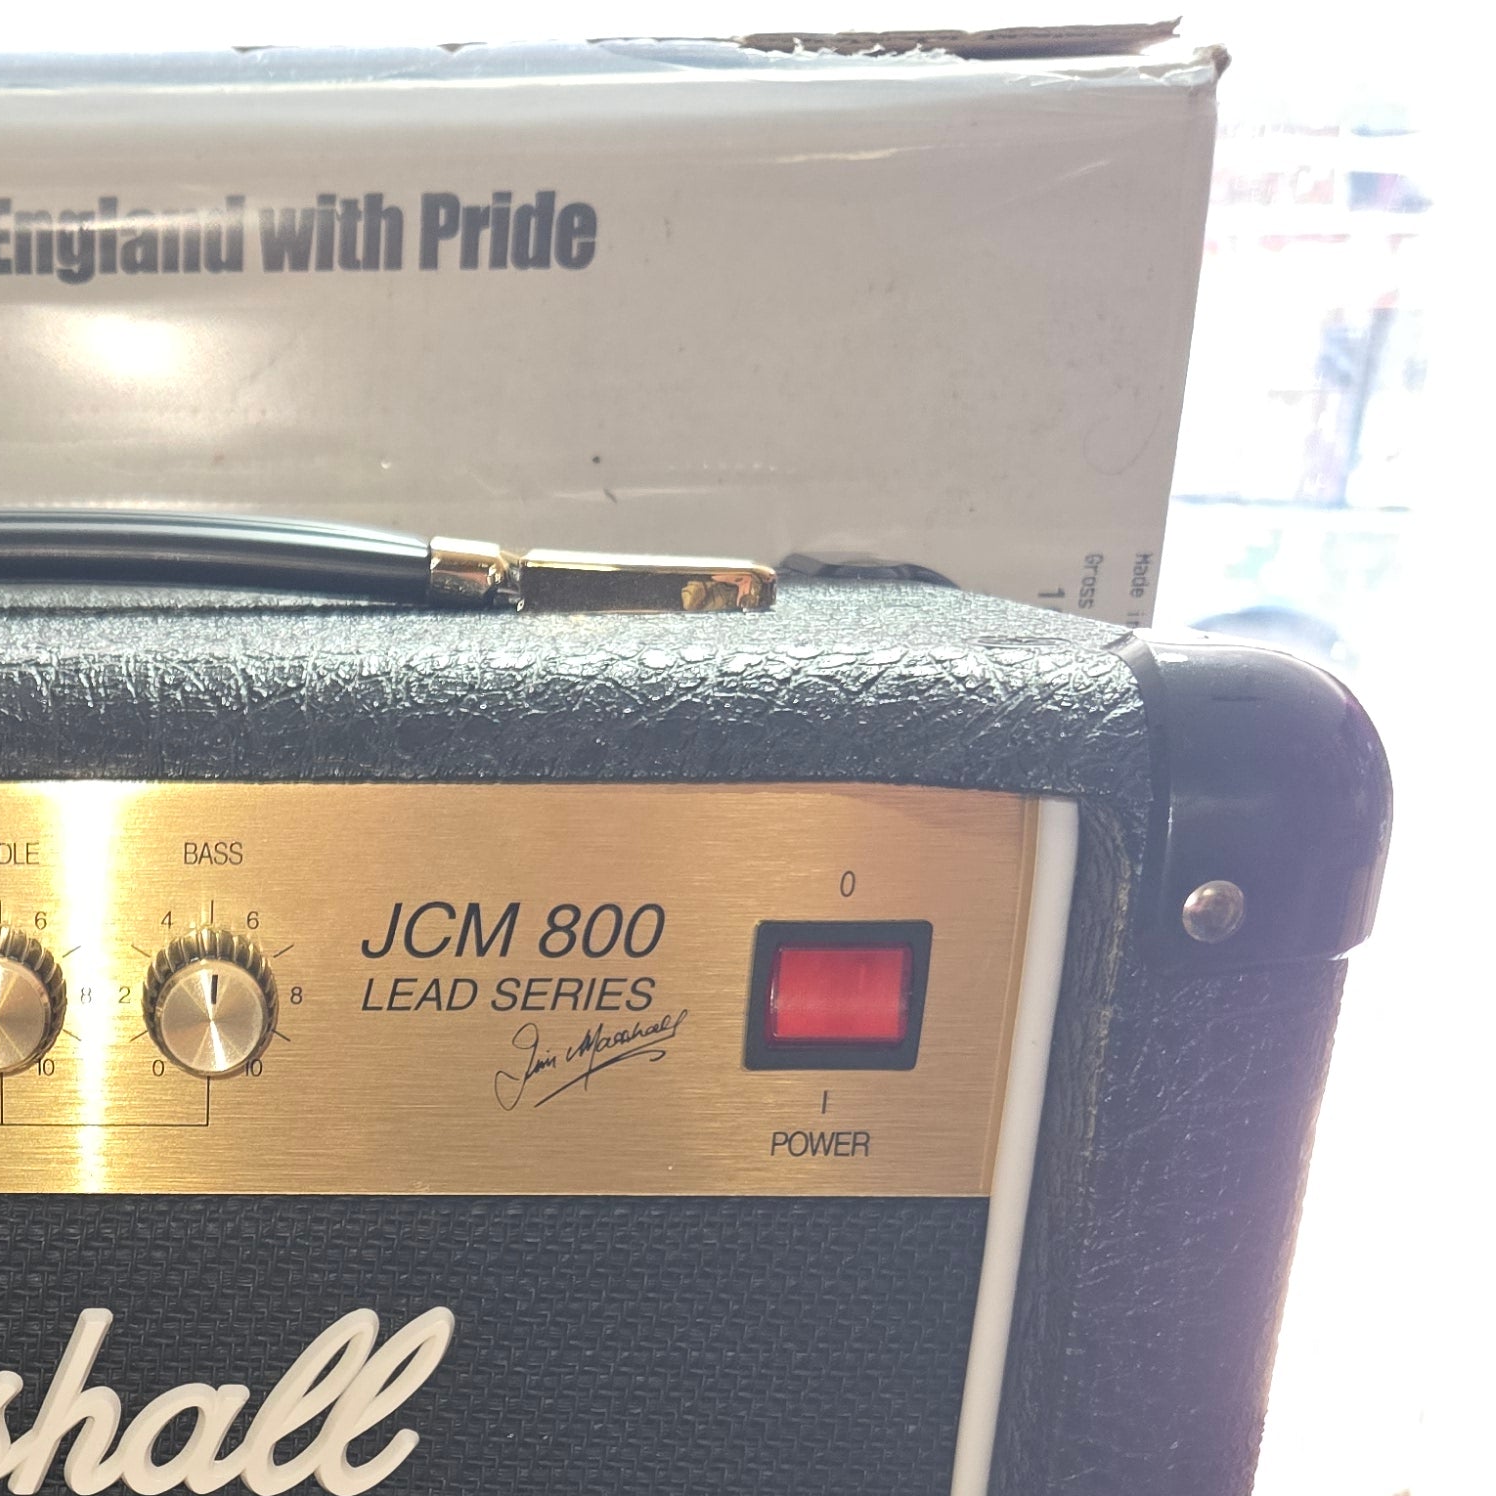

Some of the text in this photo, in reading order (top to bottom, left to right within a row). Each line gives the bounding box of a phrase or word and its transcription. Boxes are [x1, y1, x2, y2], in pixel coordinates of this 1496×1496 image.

[260, 193, 404, 272] with
[419, 191, 598, 271] Pride
[1078, 553, 1104, 609] Gross
[1129, 552, 1153, 598] Made
[184, 842, 243, 866] BASS
[35, 911, 47, 930] 6
[161, 911, 173, 929] 4
[247, 911, 259, 930] 6
[361, 902, 665, 959] JCM 800
[119, 986, 131, 1004] 2
[291, 987, 303, 1005] 8
[361, 977, 656, 1012] LEAD SERIES
[37, 1058, 55, 1077] 10
[152, 1060, 164, 1077] 0
[245, 1059, 263, 1077] 10
[770, 1131, 871, 1157] POWER
